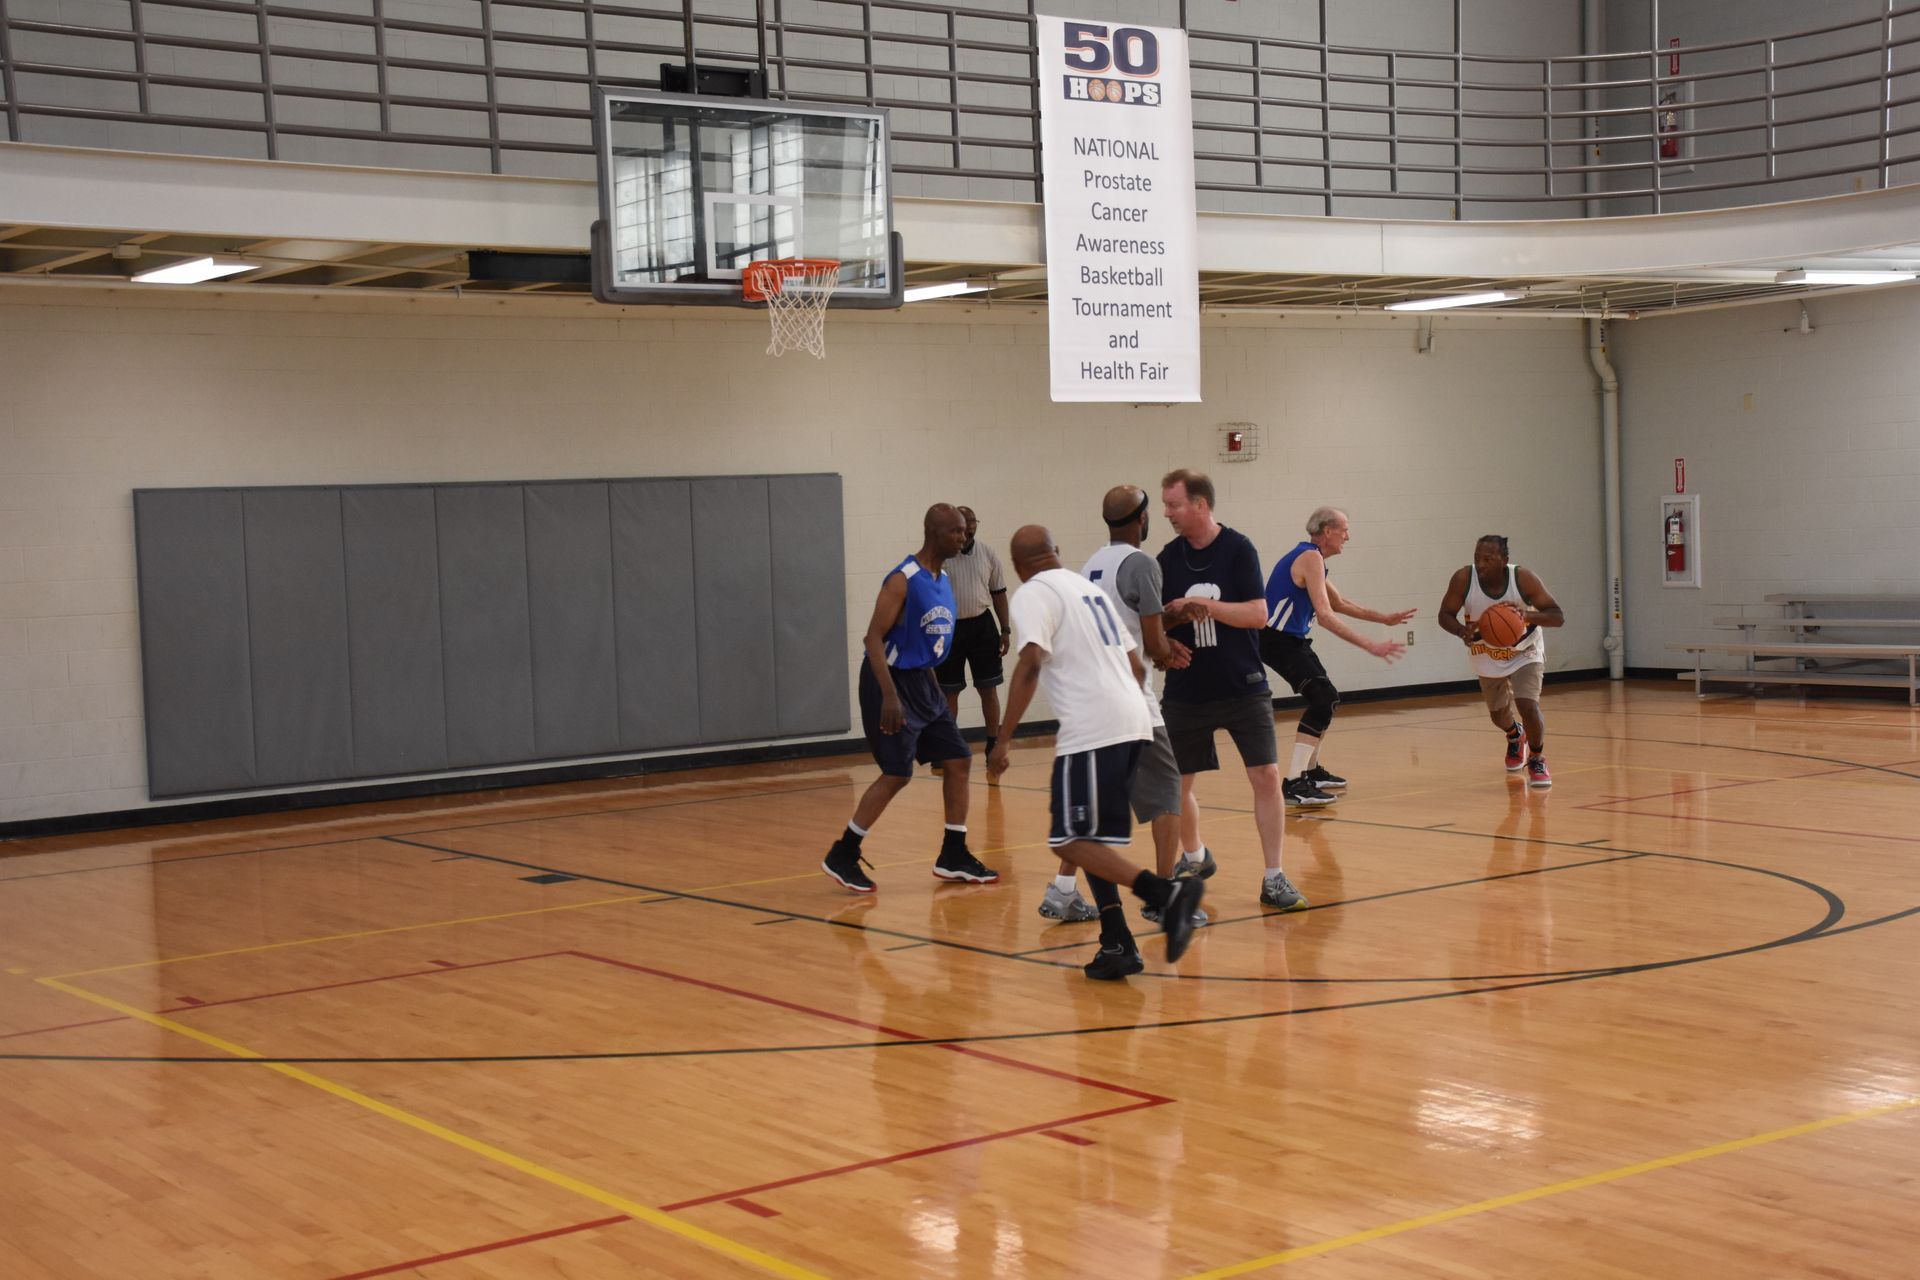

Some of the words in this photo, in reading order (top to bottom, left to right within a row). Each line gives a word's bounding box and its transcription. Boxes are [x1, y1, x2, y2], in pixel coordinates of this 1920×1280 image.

[1064, 22, 1160, 78] 50
[1069, 77, 1159, 105] HOOPS
[1074, 137, 1159, 160] NATIONAL
[1084, 170, 1151, 192] Prostate
[1092, 202, 1148, 222] Cancer
[1076, 233, 1164, 255] Awareness
[1081, 266, 1162, 286] Basketball
[1072, 298, 1172, 318] Tournament
[1109, 330, 1138, 349] and
[1081, 361, 1134, 380] Health
[1140, 362, 1169, 380] Fair
[1082, 595, 1121, 646] 11
[933, 635, 945, 658] 4
